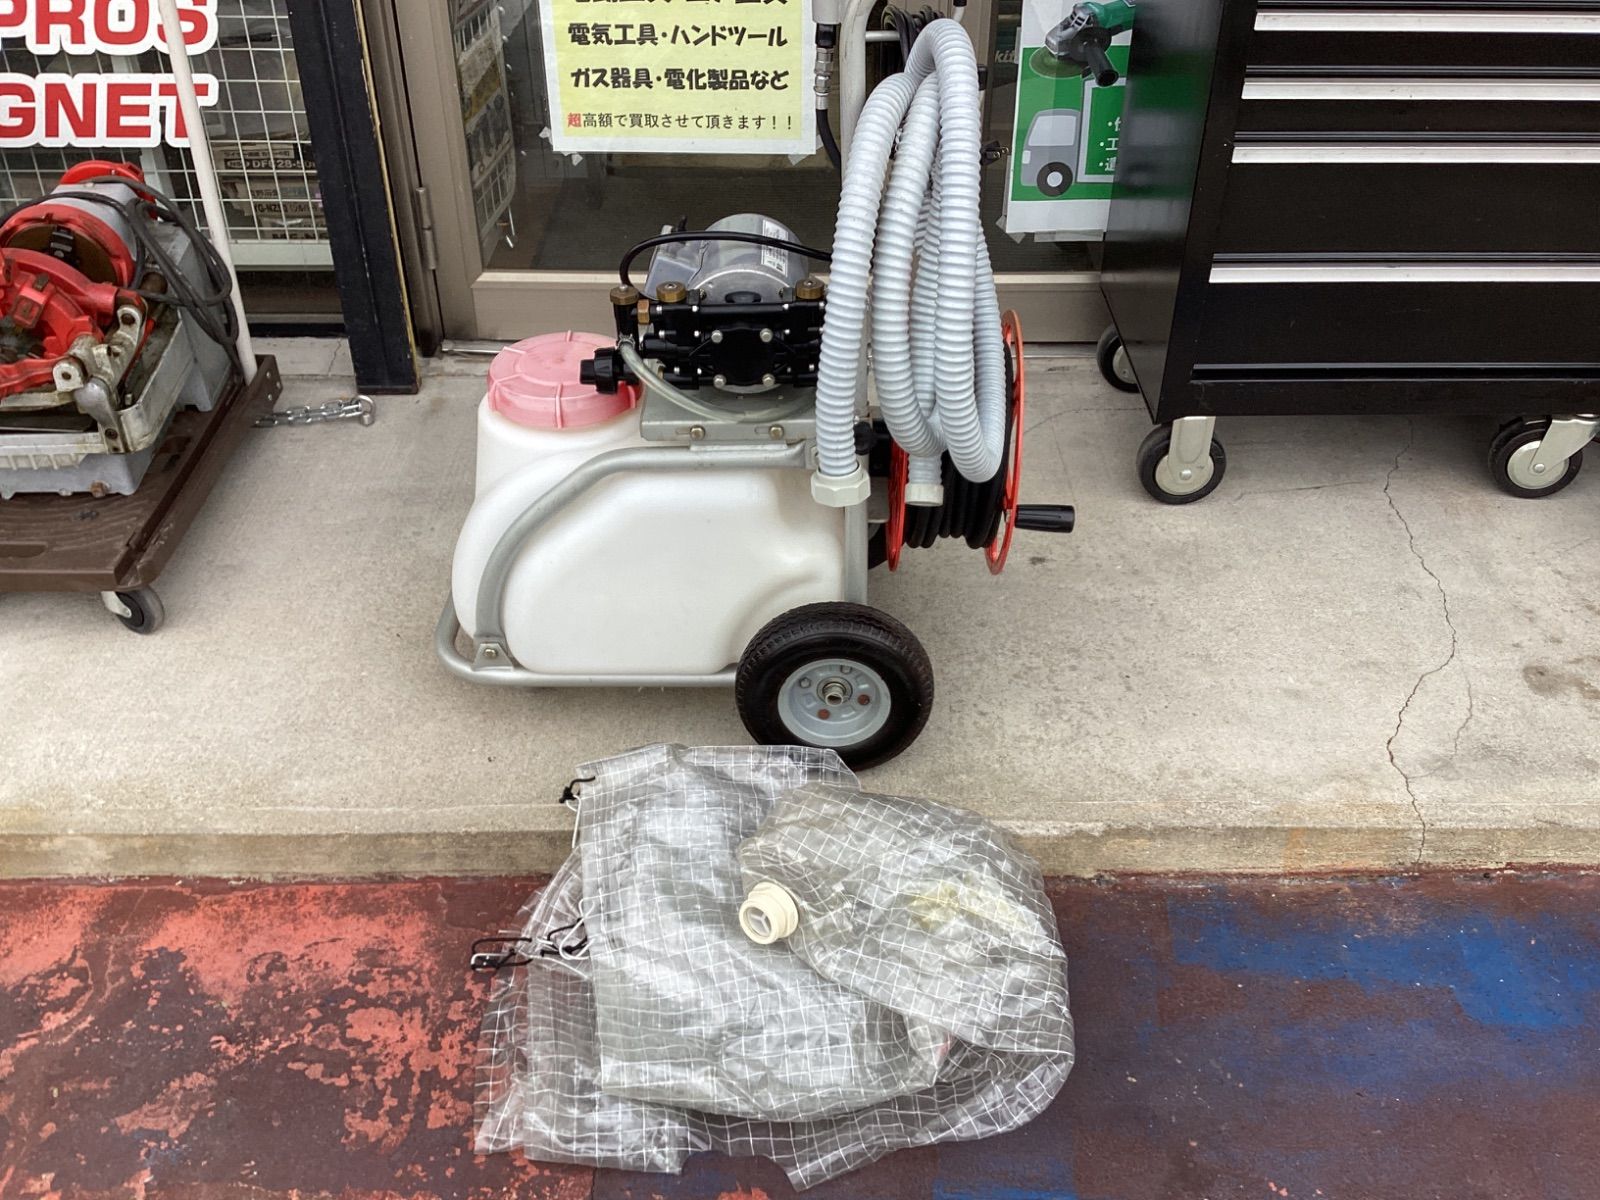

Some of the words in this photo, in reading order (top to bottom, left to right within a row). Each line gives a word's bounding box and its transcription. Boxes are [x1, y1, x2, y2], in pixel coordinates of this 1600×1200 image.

[567, 22, 788, 47] 電気工具・ハンドツール
[570, 67, 790, 91] ガス器具・電化製品など
[567, 112, 793, 131] 超高額で買取させて頂きます！！
